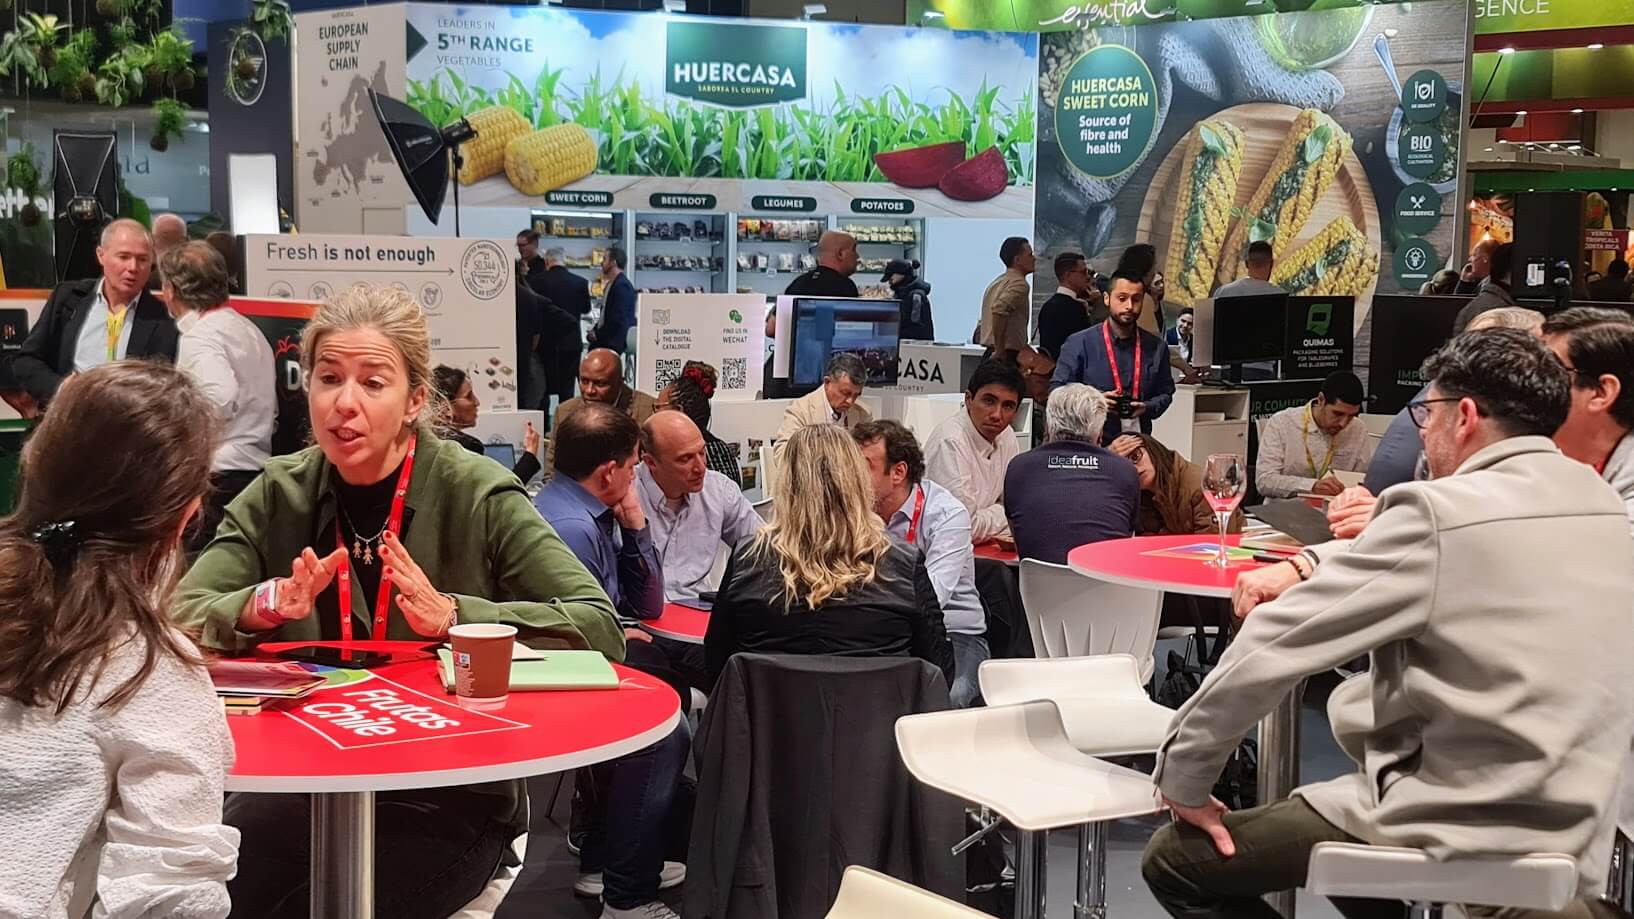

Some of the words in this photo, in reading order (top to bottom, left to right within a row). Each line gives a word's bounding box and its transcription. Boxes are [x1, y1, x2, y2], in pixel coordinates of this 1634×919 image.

[319, 22, 368, 39] EUROPEAN
[438, 18, 481, 30] LEADERS
[485, 21, 496, 31] IN
[327, 39, 360, 55] SUPPLY
[470, 36, 534, 53] RANGE
[329, 56, 358, 71] CHAIN
[437, 55, 502, 67] VEGETABLES
[674, 62, 796, 88] HUERCASA
[740, 87, 775, 95] COUNTRY
[1071, 76, 1142, 94] HUERCASA
[1063, 95, 1107, 110] SWEET
[1109, 92, 1149, 108] CORN
[1079, 115, 1117, 127] Source
[1118, 113, 1132, 125] of
[1080, 128, 1106, 141] fibre
[1107, 128, 1129, 140] and
[1086, 142, 1122, 154] health
[1410, 135, 1433, 150] BIO
[549, 193, 579, 203] SWEET
[581, 194, 608, 203] CORN
[661, 196, 707, 206] BEETROOT
[763, 199, 804, 208] LEGUMES
[860, 202, 904, 211] POTATOES
[267, 243, 317, 259] Fresh
[324, 244, 338, 260] is
[345, 246, 370, 261] not
[377, 246, 435, 265] enough
[342, 688, 461, 730] Frutas
[302, 702, 397, 736] Chile
